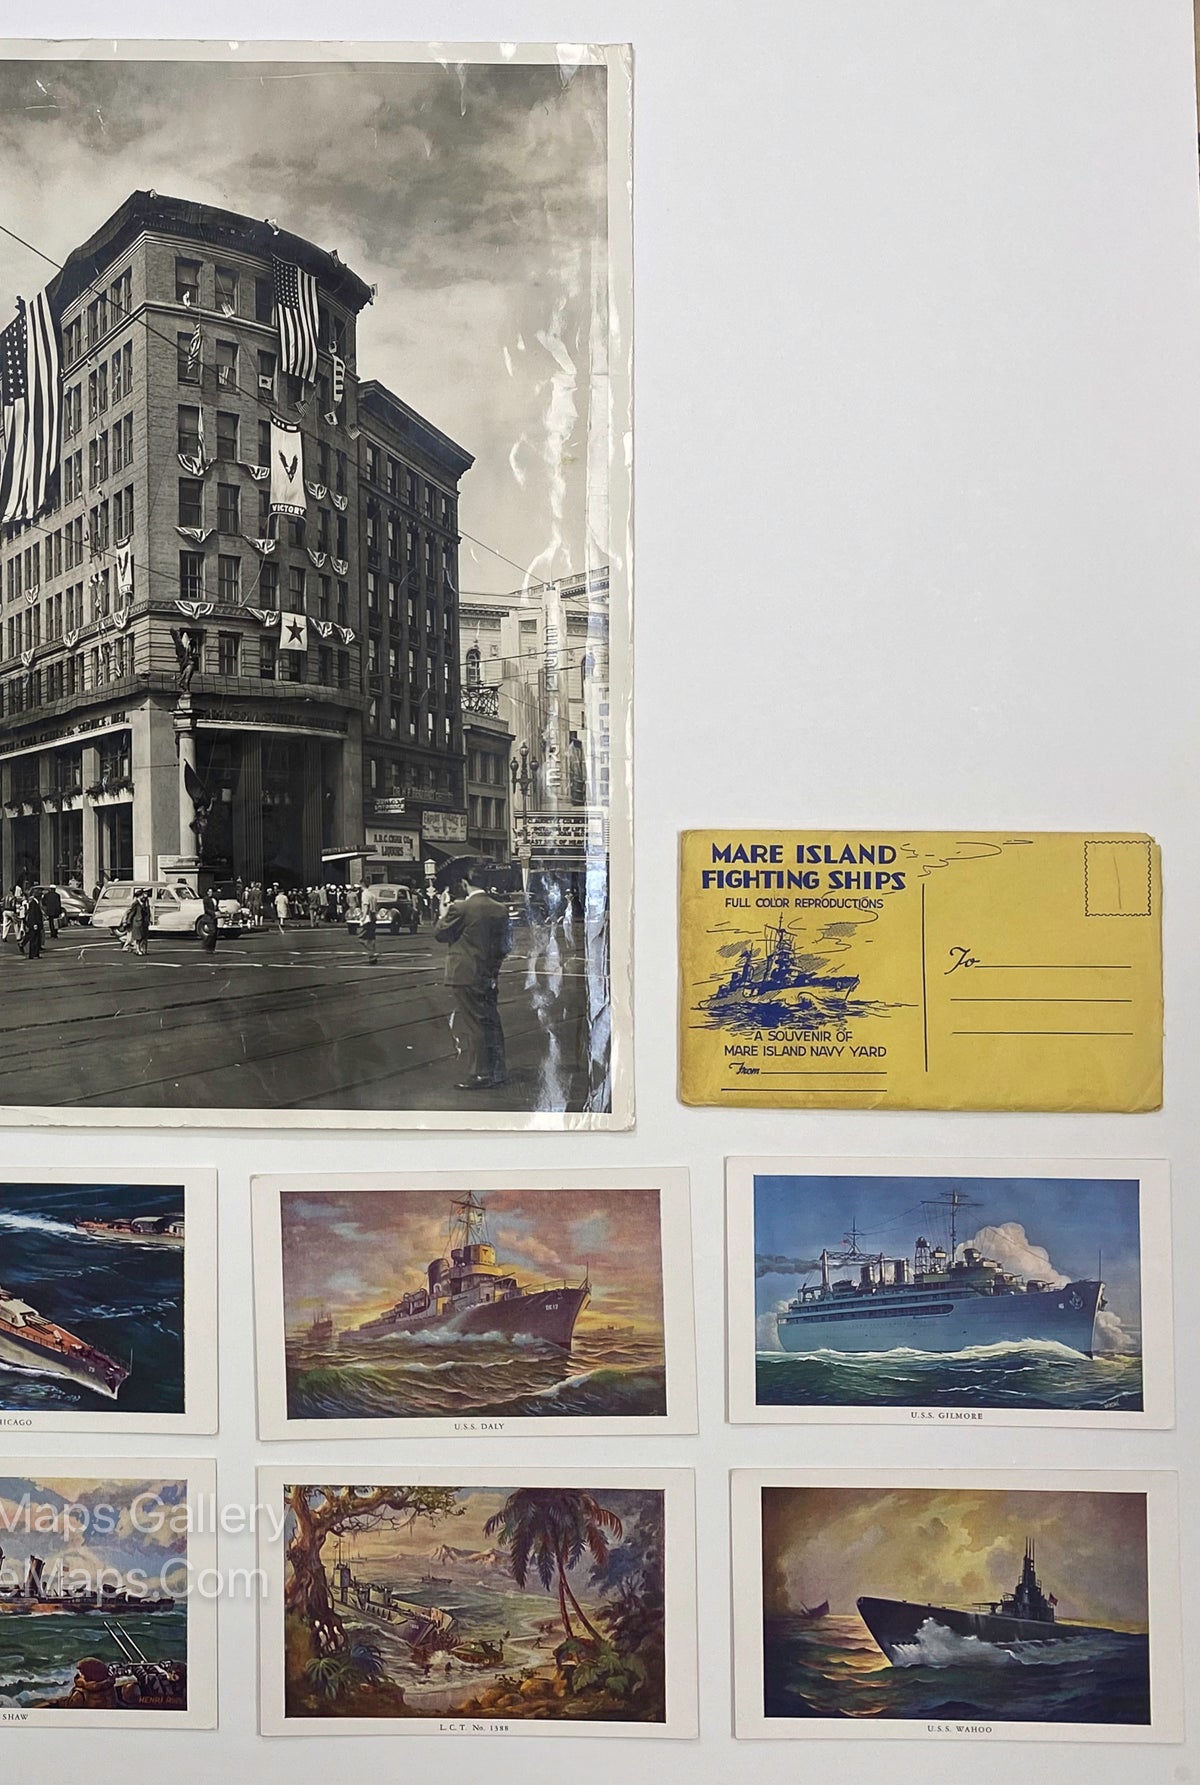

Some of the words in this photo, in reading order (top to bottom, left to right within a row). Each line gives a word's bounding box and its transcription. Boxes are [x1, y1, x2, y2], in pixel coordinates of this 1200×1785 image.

[272, 504, 306, 515] VICTORY
[711, 843, 784, 864] MARE
[796, 843, 897, 865] ISLAND
[702, 869, 819, 890] FIGHTING
[828, 870, 906, 891] SHIPS
[725, 897, 751, 908] FULL
[755, 897, 789, 908] COLOR
[795, 898, 884, 909] REPRODUCTIONS
[944, 946, 981, 975] To
[753, 1031, 763, 1041] A
[767, 1031, 831, 1041] SOUVENIR
[836, 1031, 853, 1042] OF
[724, 1046, 758, 1057] MARE
[763, 1046, 807, 1057] ISLAND
[810, 1046, 845, 1057] NAVY
[849, 1046, 887, 1057] YARD
[728, 1062, 760, 1075] From
[910, 1411, 934, 1420] U.S.S.
[938, 1412, 983, 1420] GILMORE
[454, 1423, 477, 1431] U.S.S.
[472, 1723, 485, 1731] No.
[955, 1725, 993, 1734] WAHOO
